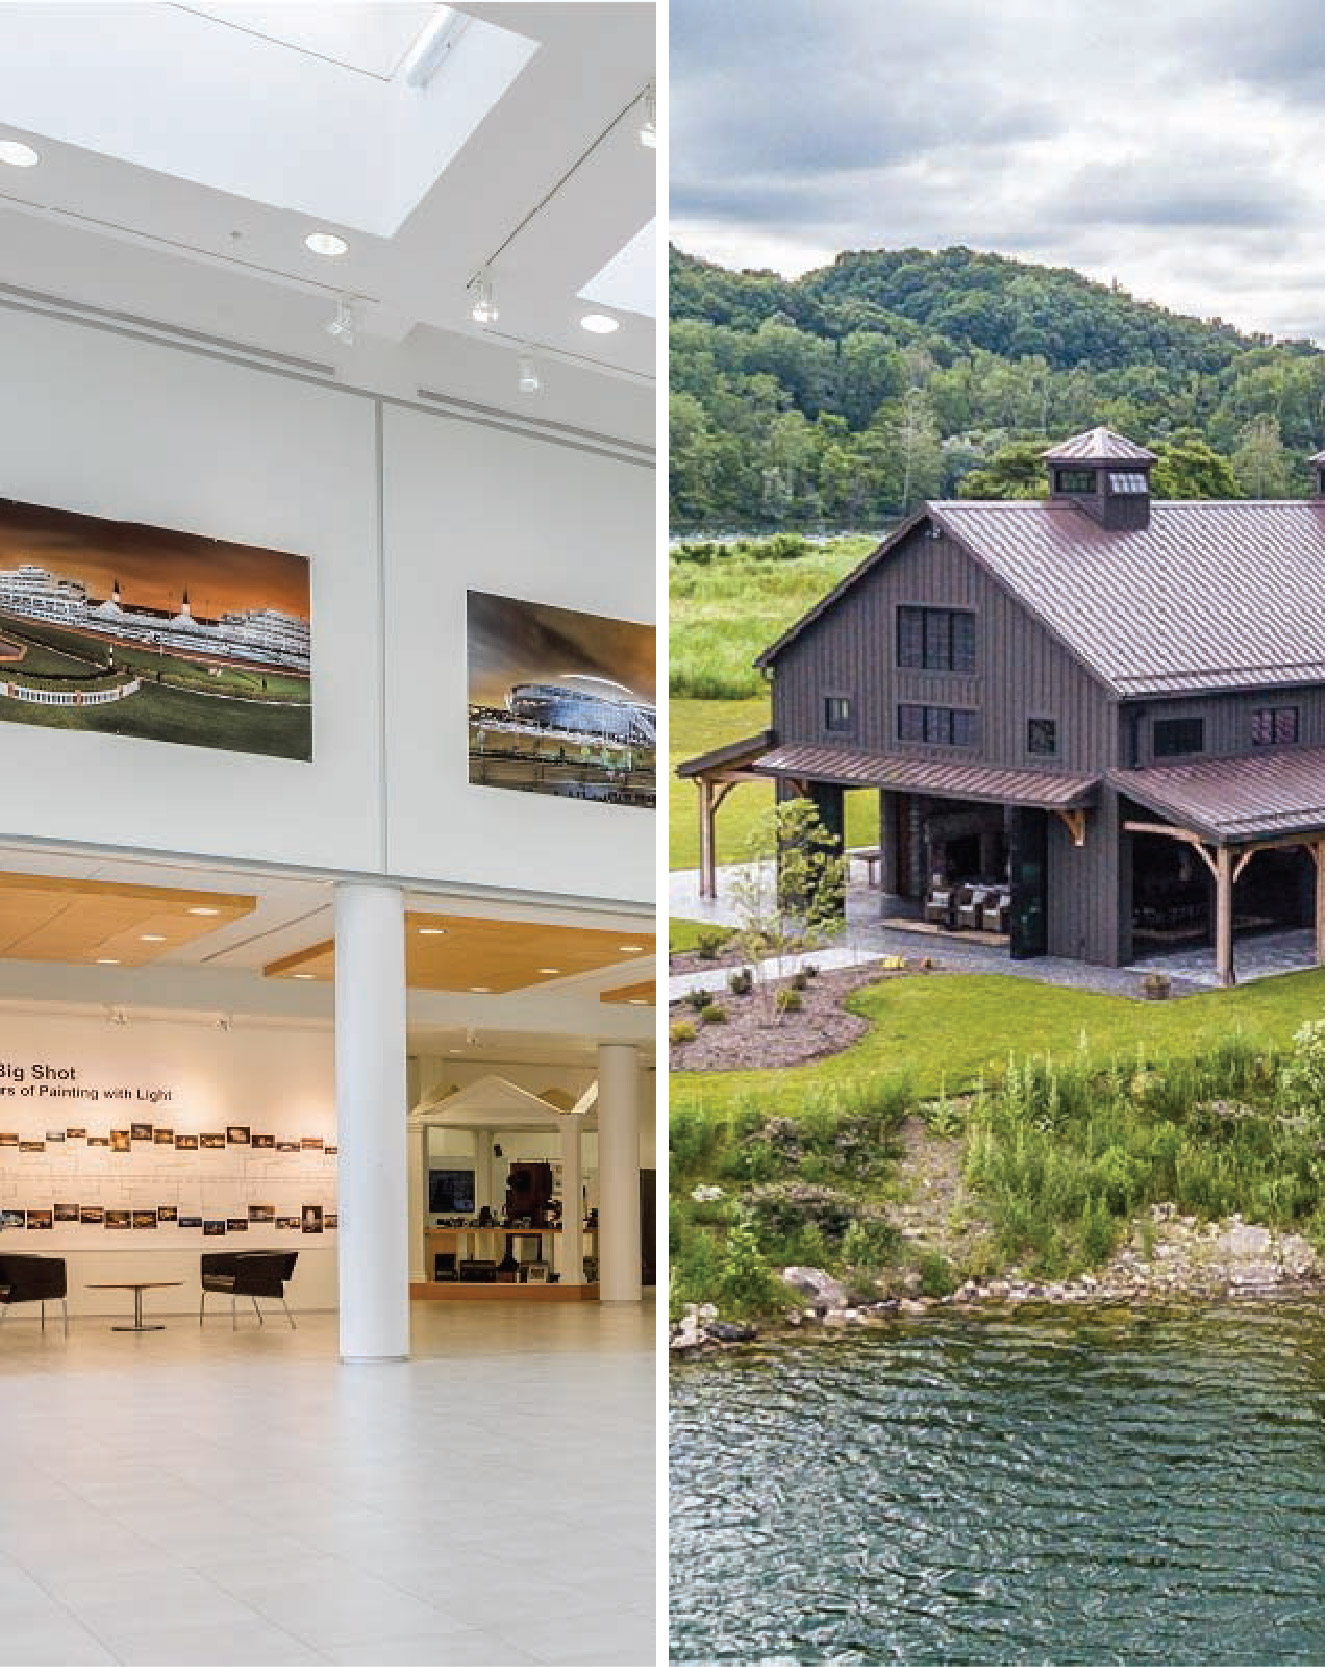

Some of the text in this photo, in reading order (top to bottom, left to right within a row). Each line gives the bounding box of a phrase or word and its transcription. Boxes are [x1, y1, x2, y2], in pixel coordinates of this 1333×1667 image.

[31, 1064, 76, 1080] Shot
[20, 1085, 34, 1096] of
[39, 1085, 99, 1100] Painting
[104, 1088, 132, 1100] with
[136, 1089, 172, 1102] Light
